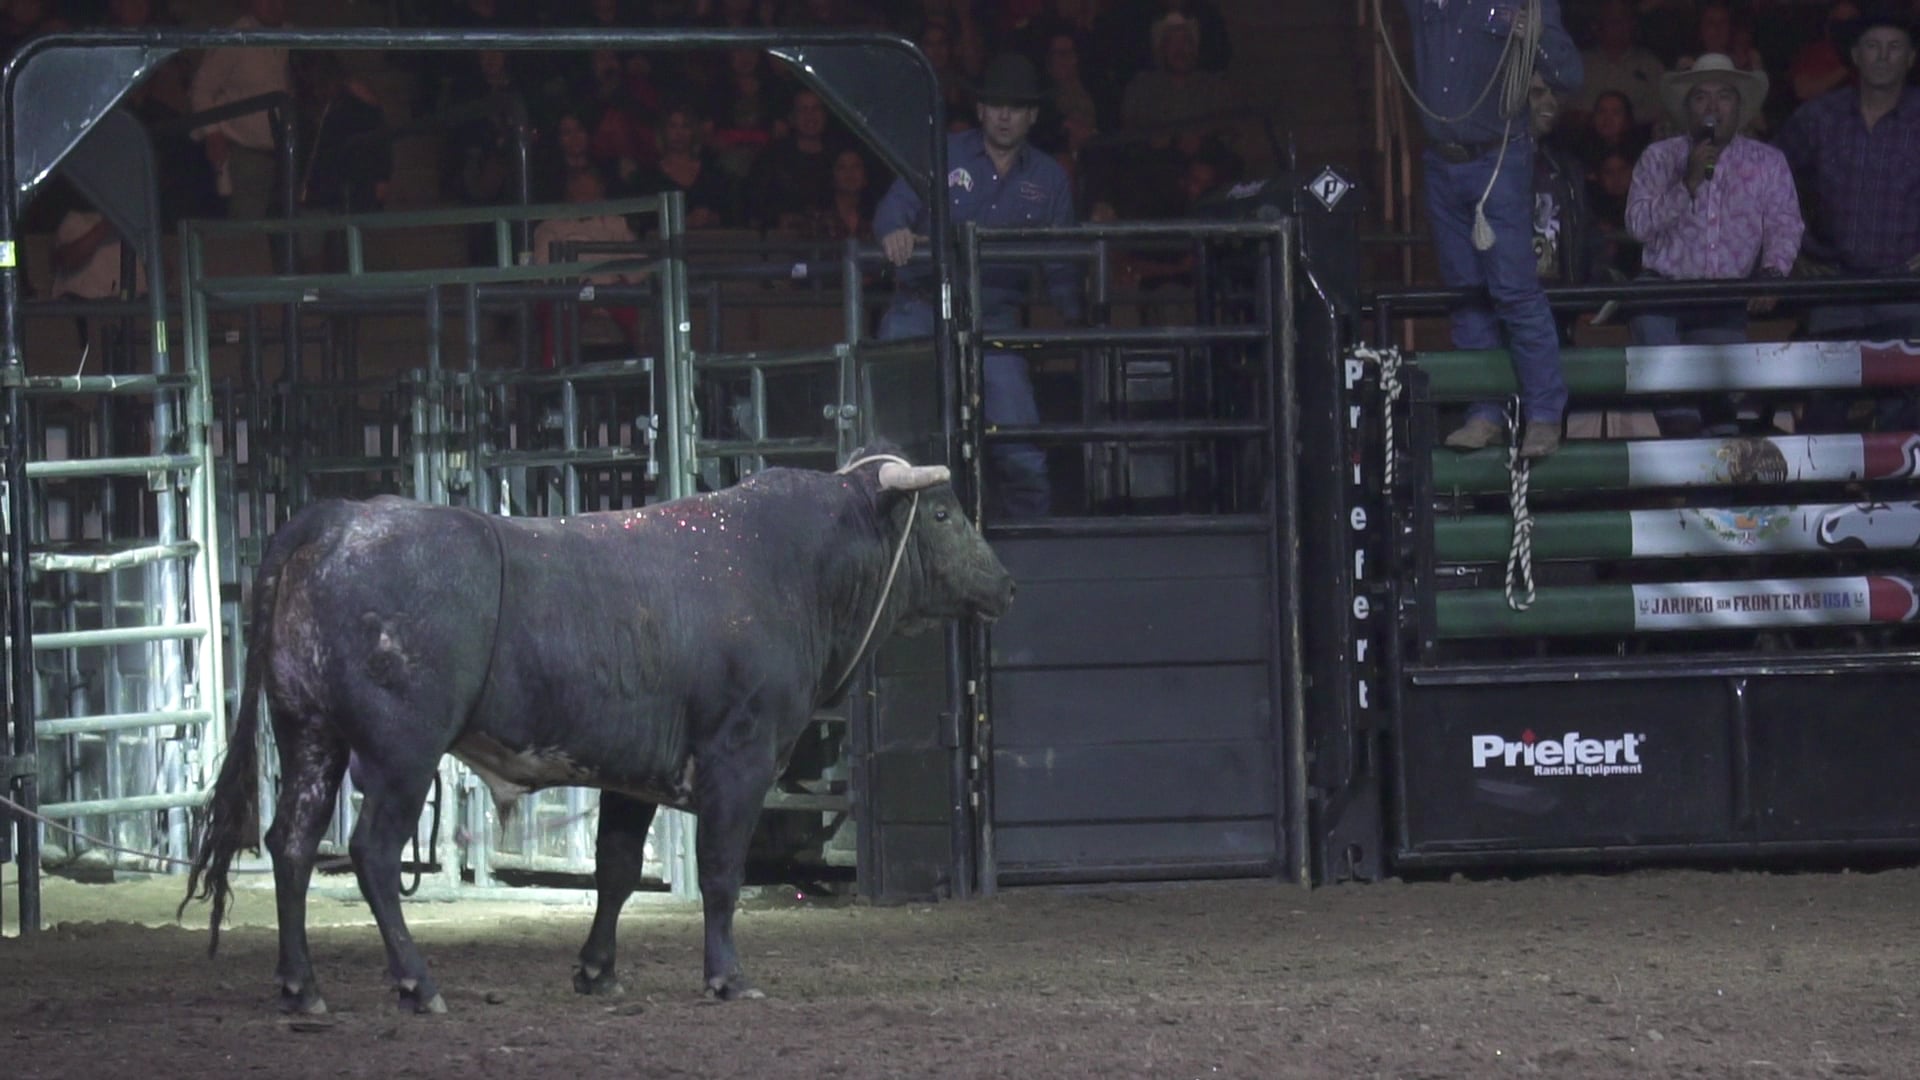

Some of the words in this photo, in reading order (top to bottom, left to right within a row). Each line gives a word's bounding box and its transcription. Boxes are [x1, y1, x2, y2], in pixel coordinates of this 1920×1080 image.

[1345, 359, 1369, 709] Priefert
[1652, 596, 1713, 615] JARIPEO
[1716, 599, 1731, 610] SIN
[1733, 592, 1821, 612] FRONTERAS
[1823, 591, 1850, 609] USA
[1472, 729, 1641, 768] Priefert
[1534, 764, 1573, 776] Ranch
[1576, 763, 1642, 777] Equipment
